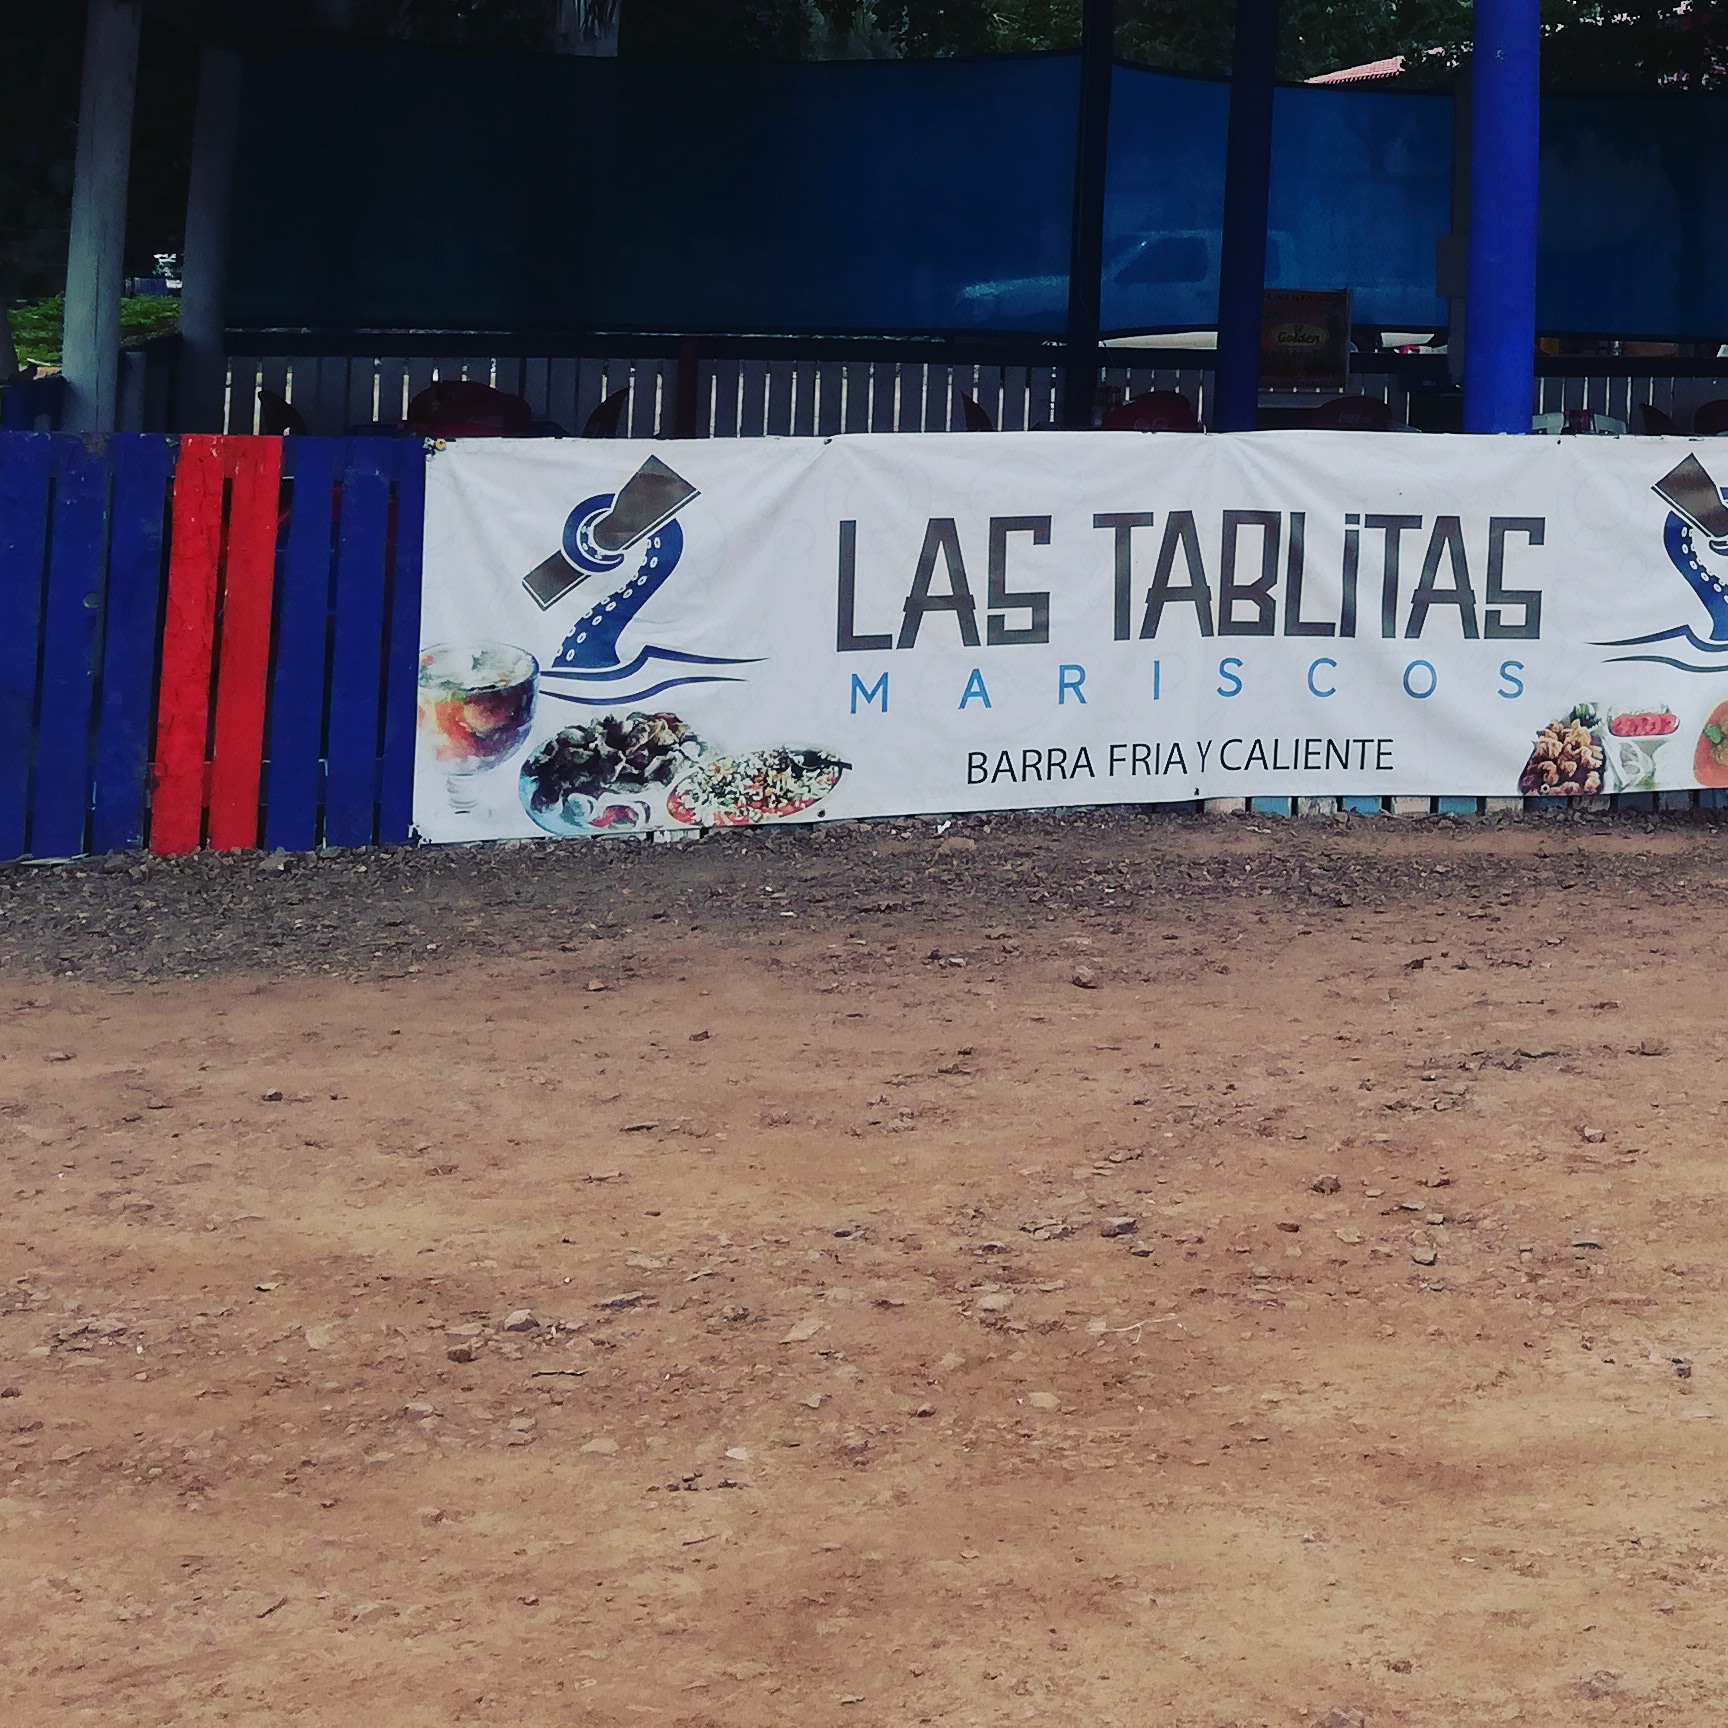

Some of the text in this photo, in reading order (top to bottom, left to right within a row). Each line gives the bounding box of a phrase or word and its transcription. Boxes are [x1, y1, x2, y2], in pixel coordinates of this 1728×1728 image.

[1276, 331, 1321, 345] Golden
[836, 514, 1052, 652] LAS
[850, 657, 1525, 714] MARISCOS
[967, 737, 1394, 785] BARRA FRIA Y CALIENTE
